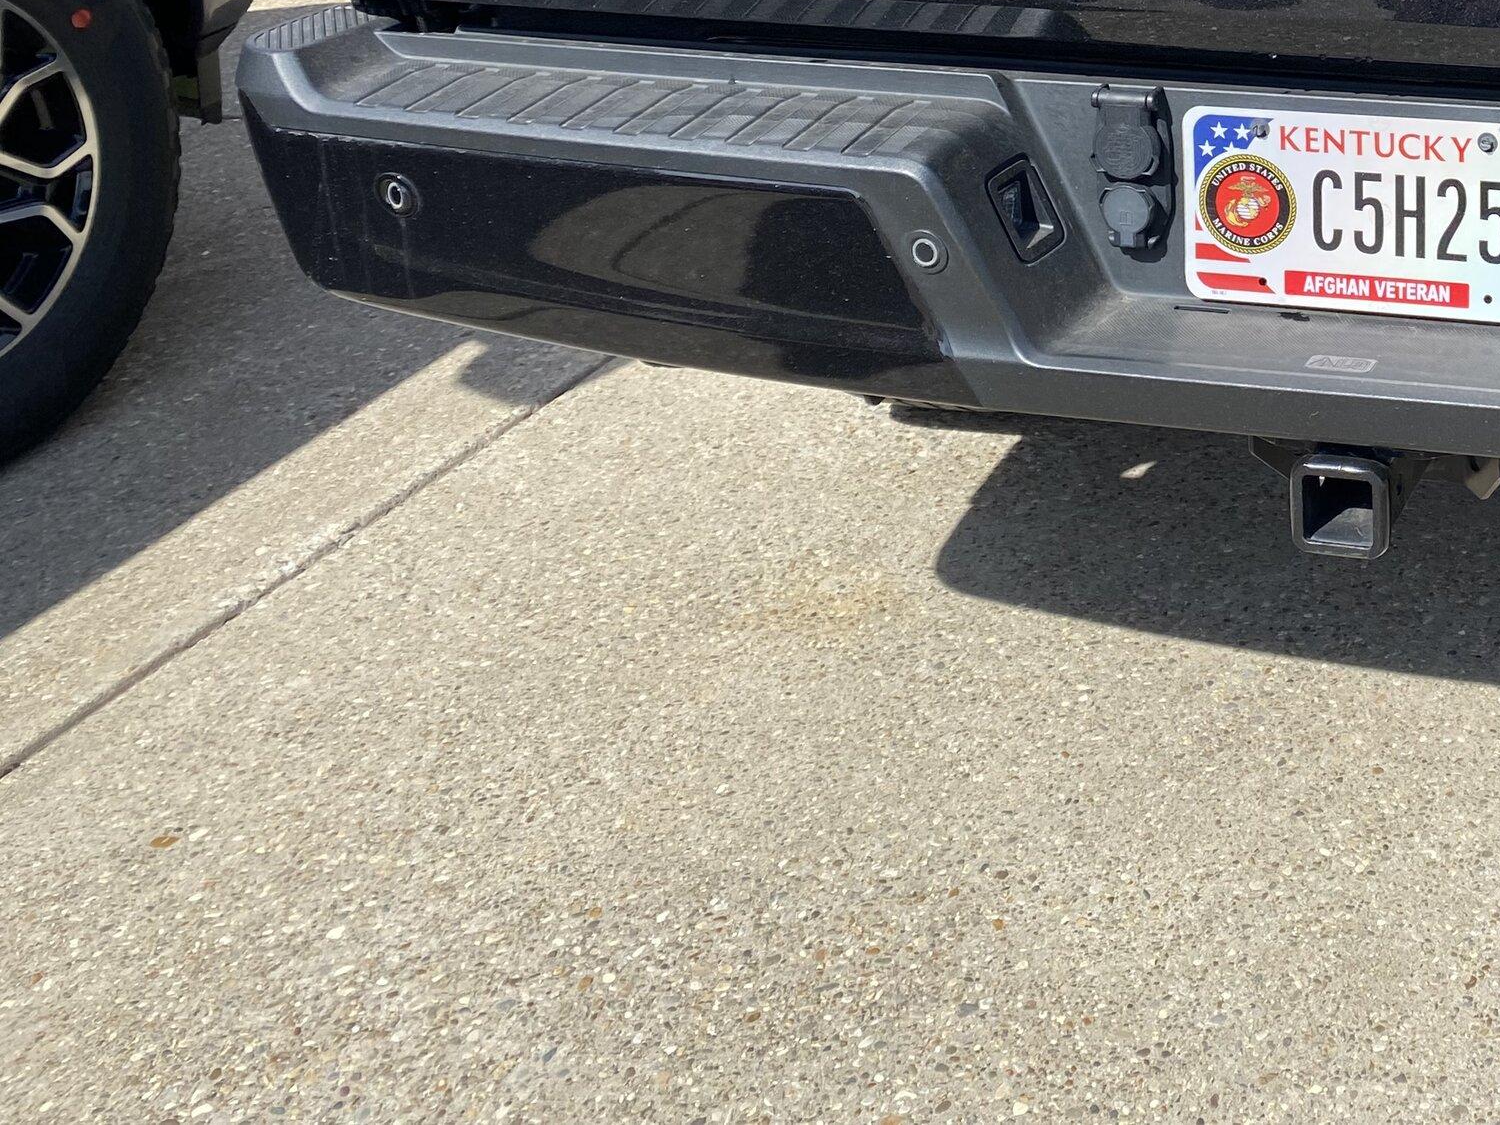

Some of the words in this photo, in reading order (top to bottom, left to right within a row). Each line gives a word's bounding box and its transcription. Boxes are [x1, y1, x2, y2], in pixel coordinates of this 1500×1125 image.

[1279, 125, 1473, 163] KENTUCKY
[1211, 162, 1247, 187] UNITED
[1249, 163, 1284, 191] STATES
[1212, 217, 1251, 246] MARINE
[1253, 222, 1284, 246] CORPS
[1303, 275, 1370, 298] AFGHAN
[1376, 281, 1451, 303] VETERAN
